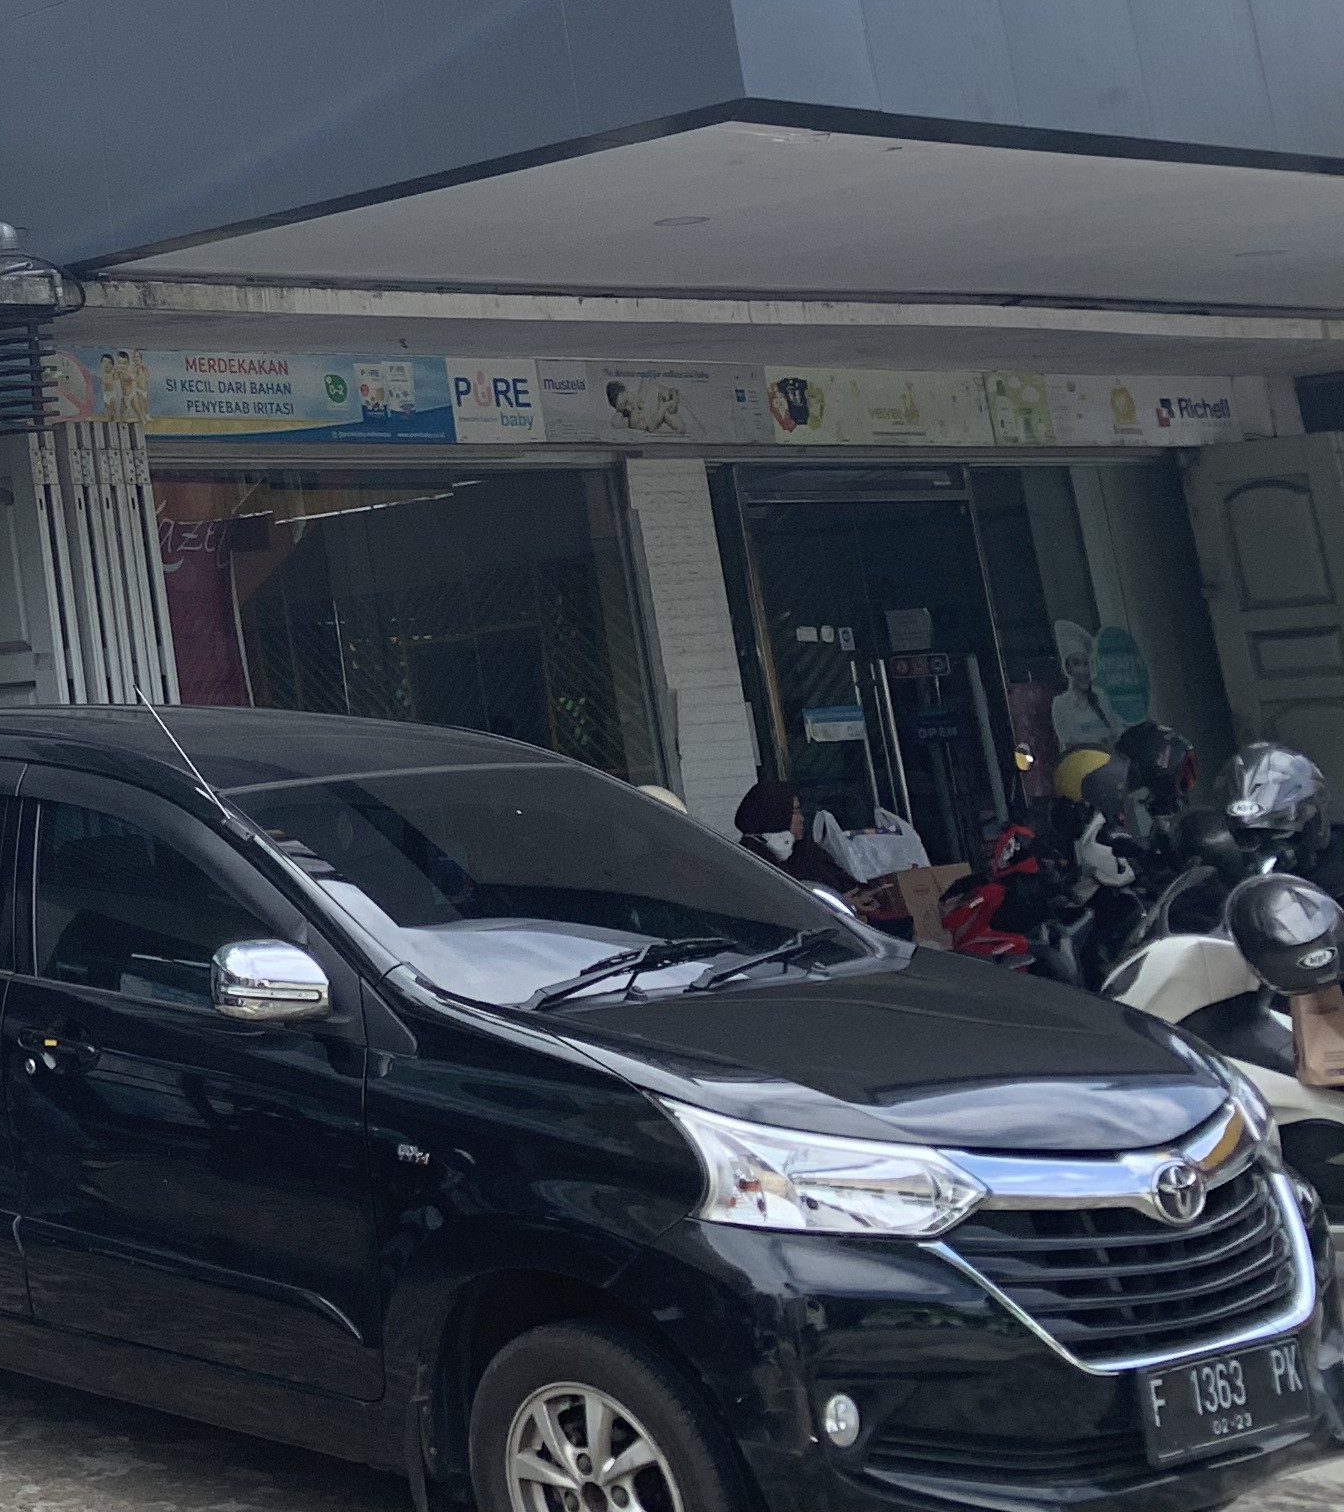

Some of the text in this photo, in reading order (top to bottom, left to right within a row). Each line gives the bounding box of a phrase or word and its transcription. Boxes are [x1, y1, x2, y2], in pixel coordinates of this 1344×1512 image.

[185, 356, 289, 376] MERDEKAKAN
[166, 378, 292, 395] SI KECIL DARI BAHAN
[186, 399, 294, 415] PENYEBAB IRITASI
[1176, 396, 1231, 419] Richell
[499, 410, 534, 431] baby
[1148, 1345, 1303, 1427] F 1363 PK
